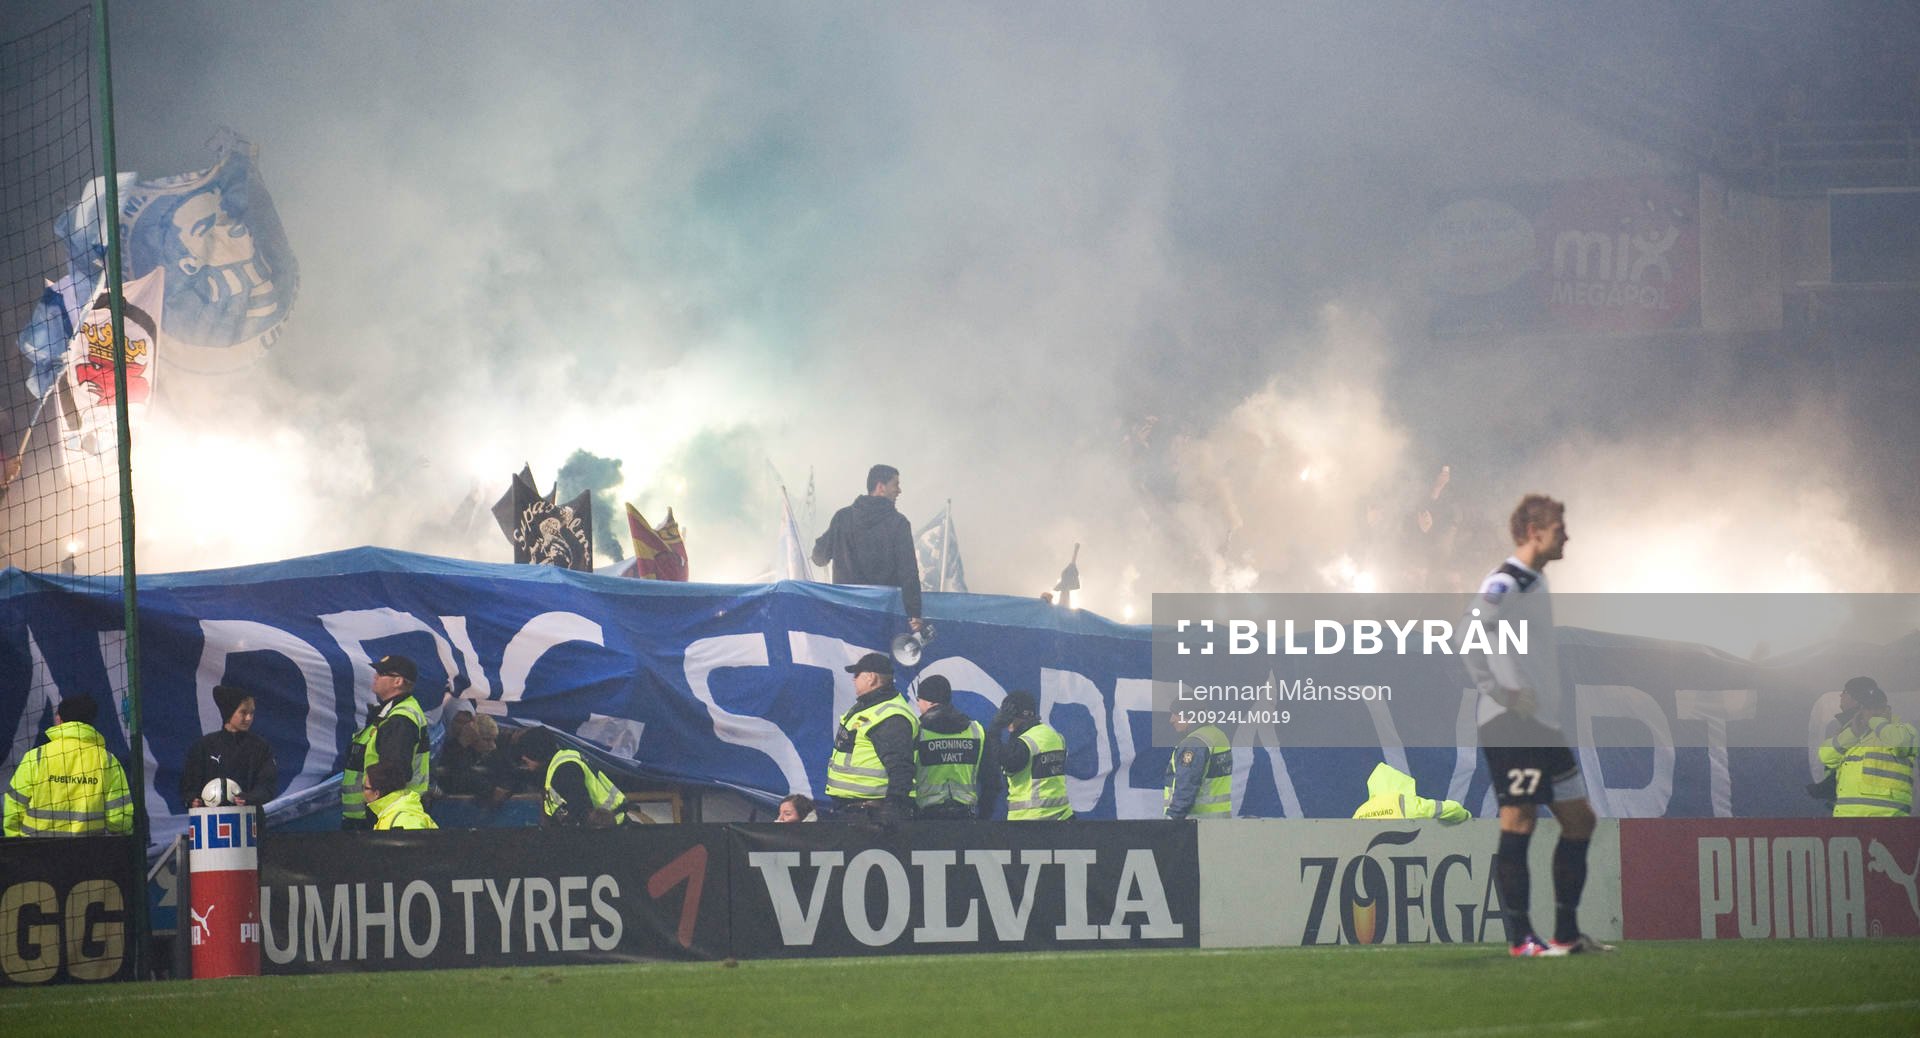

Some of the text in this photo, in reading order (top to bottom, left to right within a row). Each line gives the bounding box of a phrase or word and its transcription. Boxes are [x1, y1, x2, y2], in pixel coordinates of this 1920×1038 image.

[1550, 281, 1671, 310] MEGAPOL
[928, 740, 974, 751] ORDNINGS
[941, 752, 964, 762] VAKT
[1507, 768, 1541, 796] 27
[748, 848, 1184, 947] VOLVIA
[1697, 836, 1868, 939] PUMA
[1, 880, 125, 984] GG
[260, 874, 623, 964] UMHO TYRES
